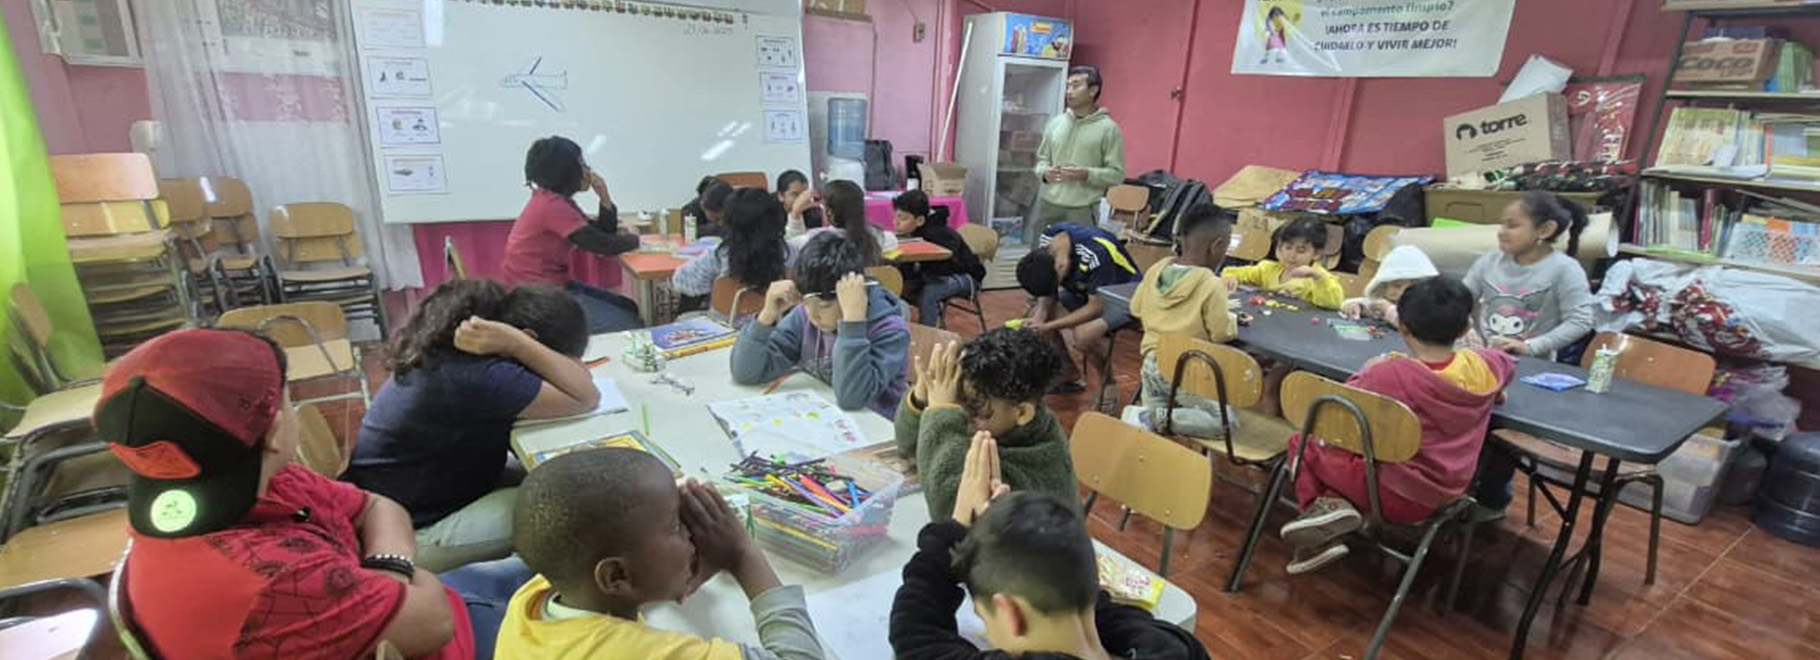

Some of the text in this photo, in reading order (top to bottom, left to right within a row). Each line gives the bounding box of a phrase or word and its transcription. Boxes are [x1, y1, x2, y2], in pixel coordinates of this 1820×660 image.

[1367, 22, 1381, 33] ES
[1383, 20, 1429, 33] TIEMPO
[1432, 20, 1451, 30] DE
[1366, 40, 1375, 50] Y
[1377, 39, 1409, 50] VIVIR
[1411, 38, 1457, 50] MEJOR!
[1480, 114, 1528, 135] torre
